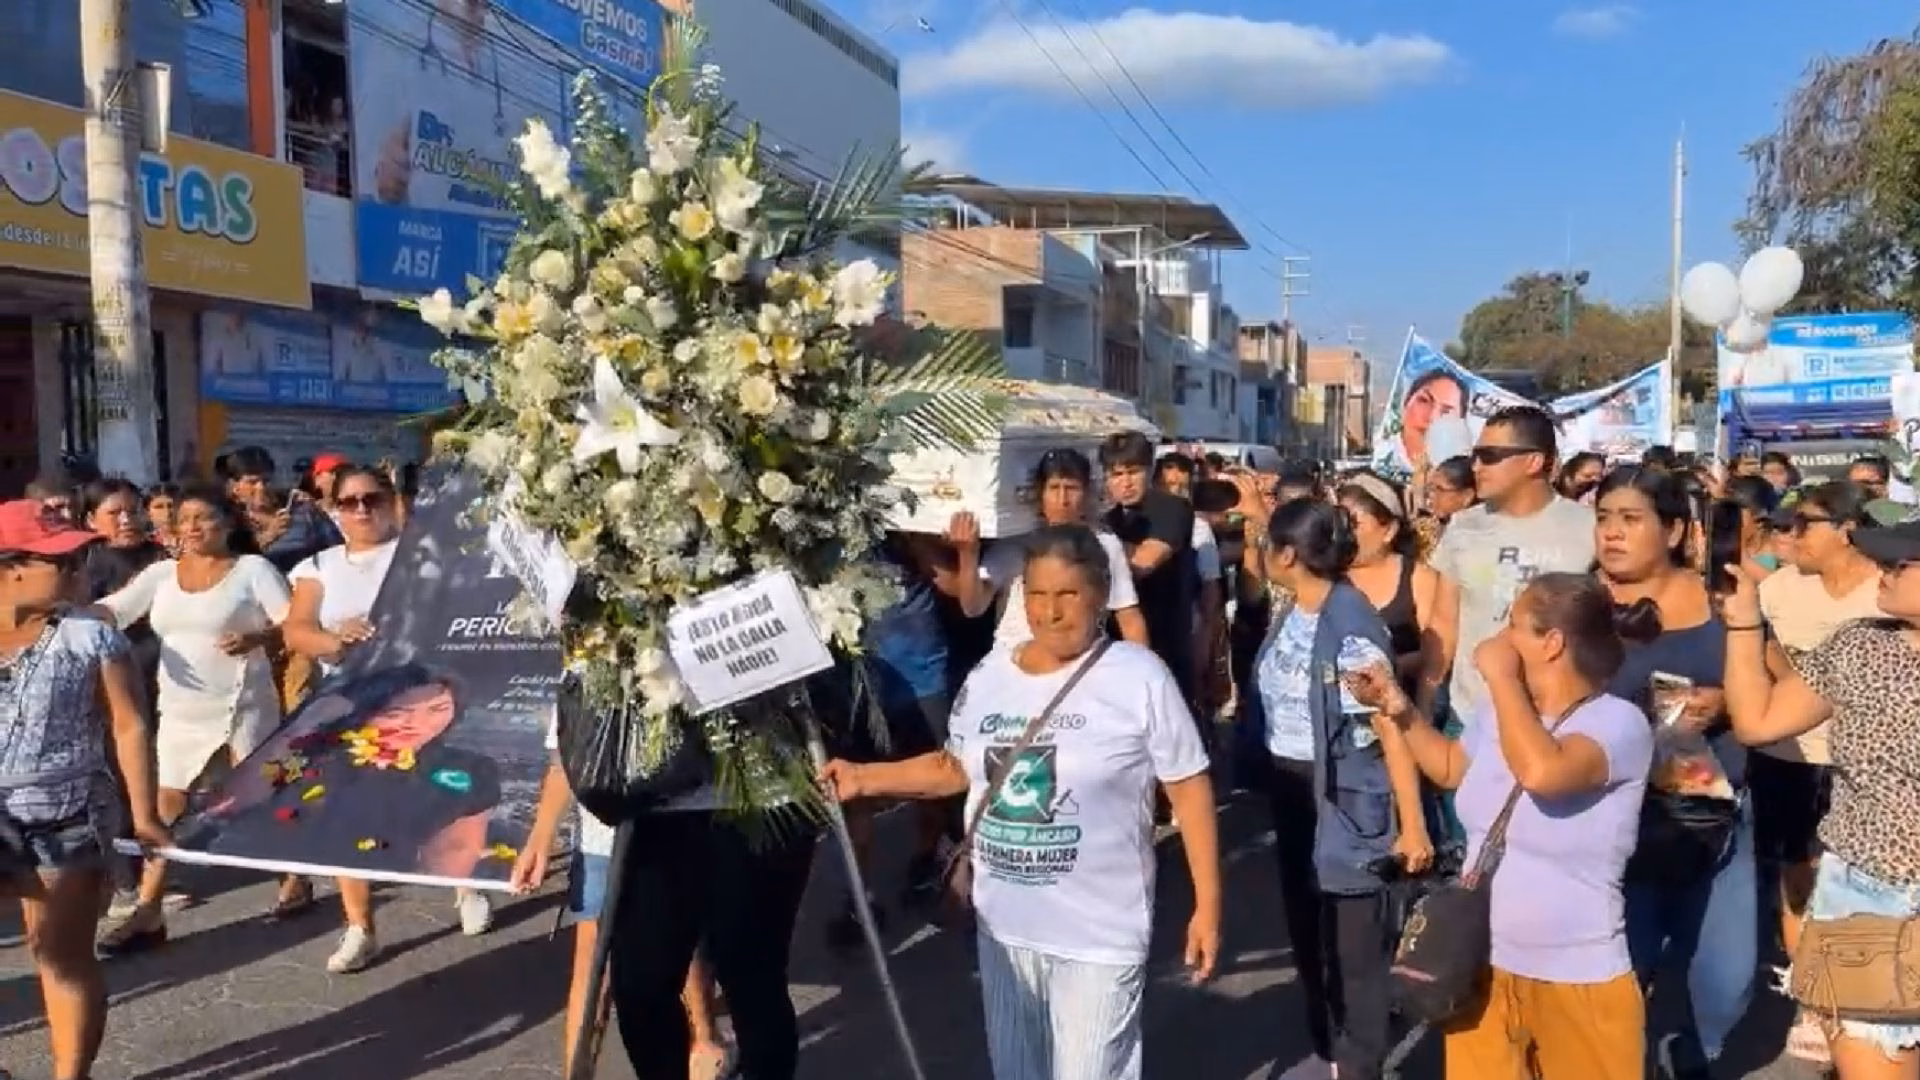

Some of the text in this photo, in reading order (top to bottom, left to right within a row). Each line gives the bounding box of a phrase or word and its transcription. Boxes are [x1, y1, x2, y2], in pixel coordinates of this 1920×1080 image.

[558, 0, 647, 42] OVEMOS
[4, 223, 52, 246] desde
[399, 219, 442, 241] MARCA
[391, 246, 442, 279] ASÍ
[693, 617, 788, 665] NO LA CALLA
[1036, 847, 1078, 863] MUJER
